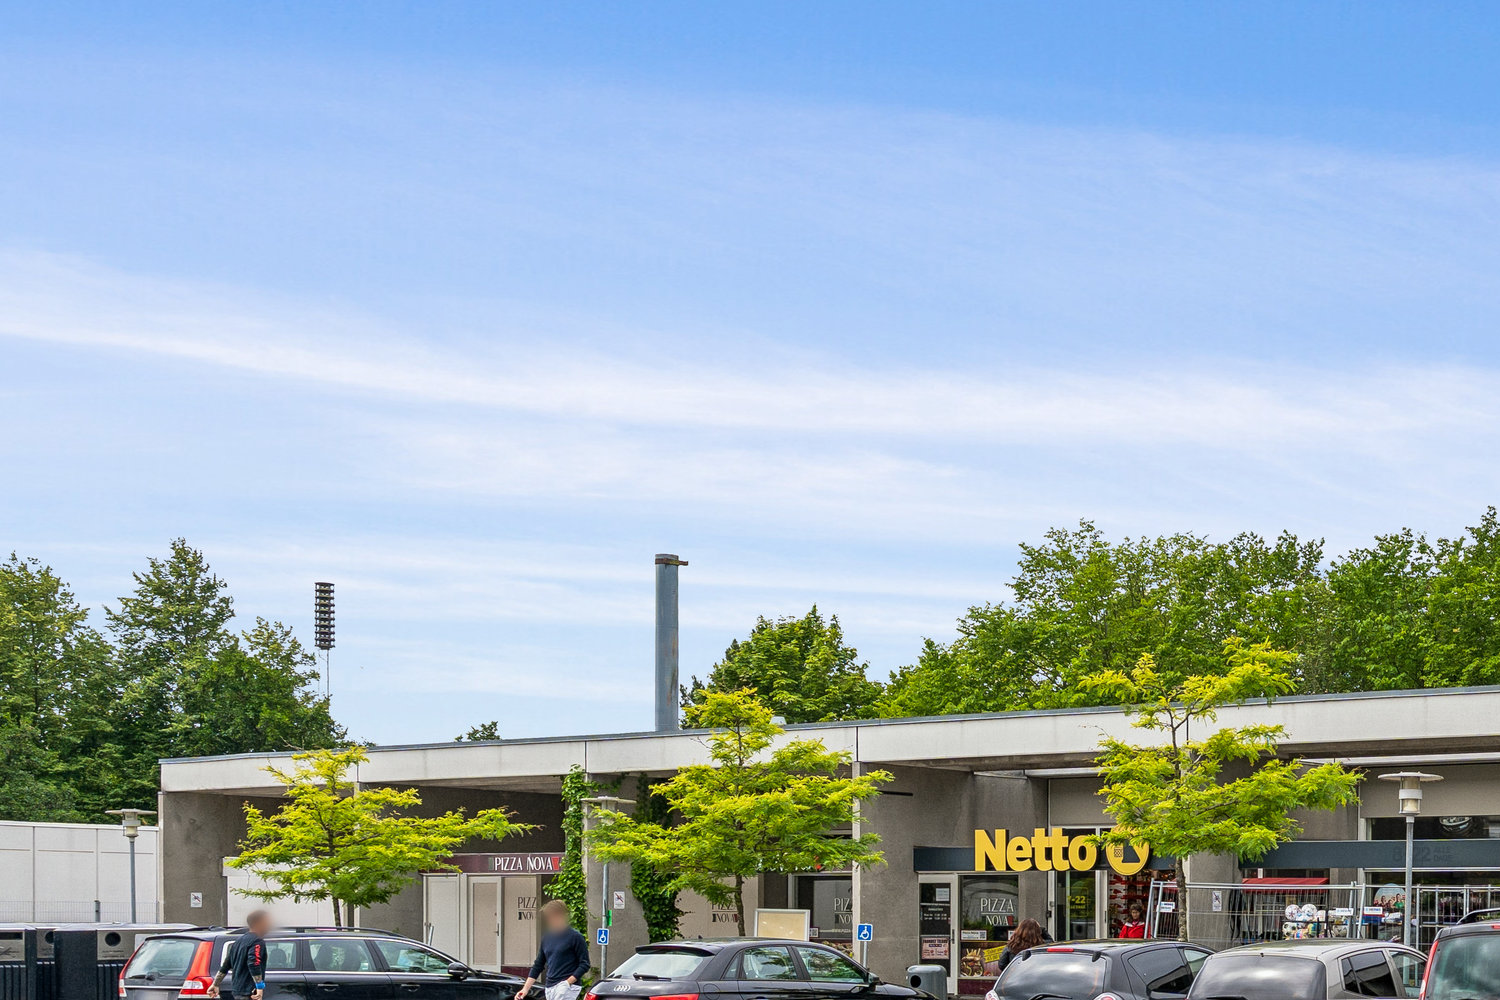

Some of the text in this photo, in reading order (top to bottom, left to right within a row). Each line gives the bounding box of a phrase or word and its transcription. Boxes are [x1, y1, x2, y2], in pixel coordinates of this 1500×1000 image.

[974, 828, 1098, 872] Netto
[495, 857, 553, 871] PIZZA NOVA
[834, 897, 853, 911] PIZ
[980, 898, 1014, 912] PIZZA
[986, 914, 1009, 926] NOVA
